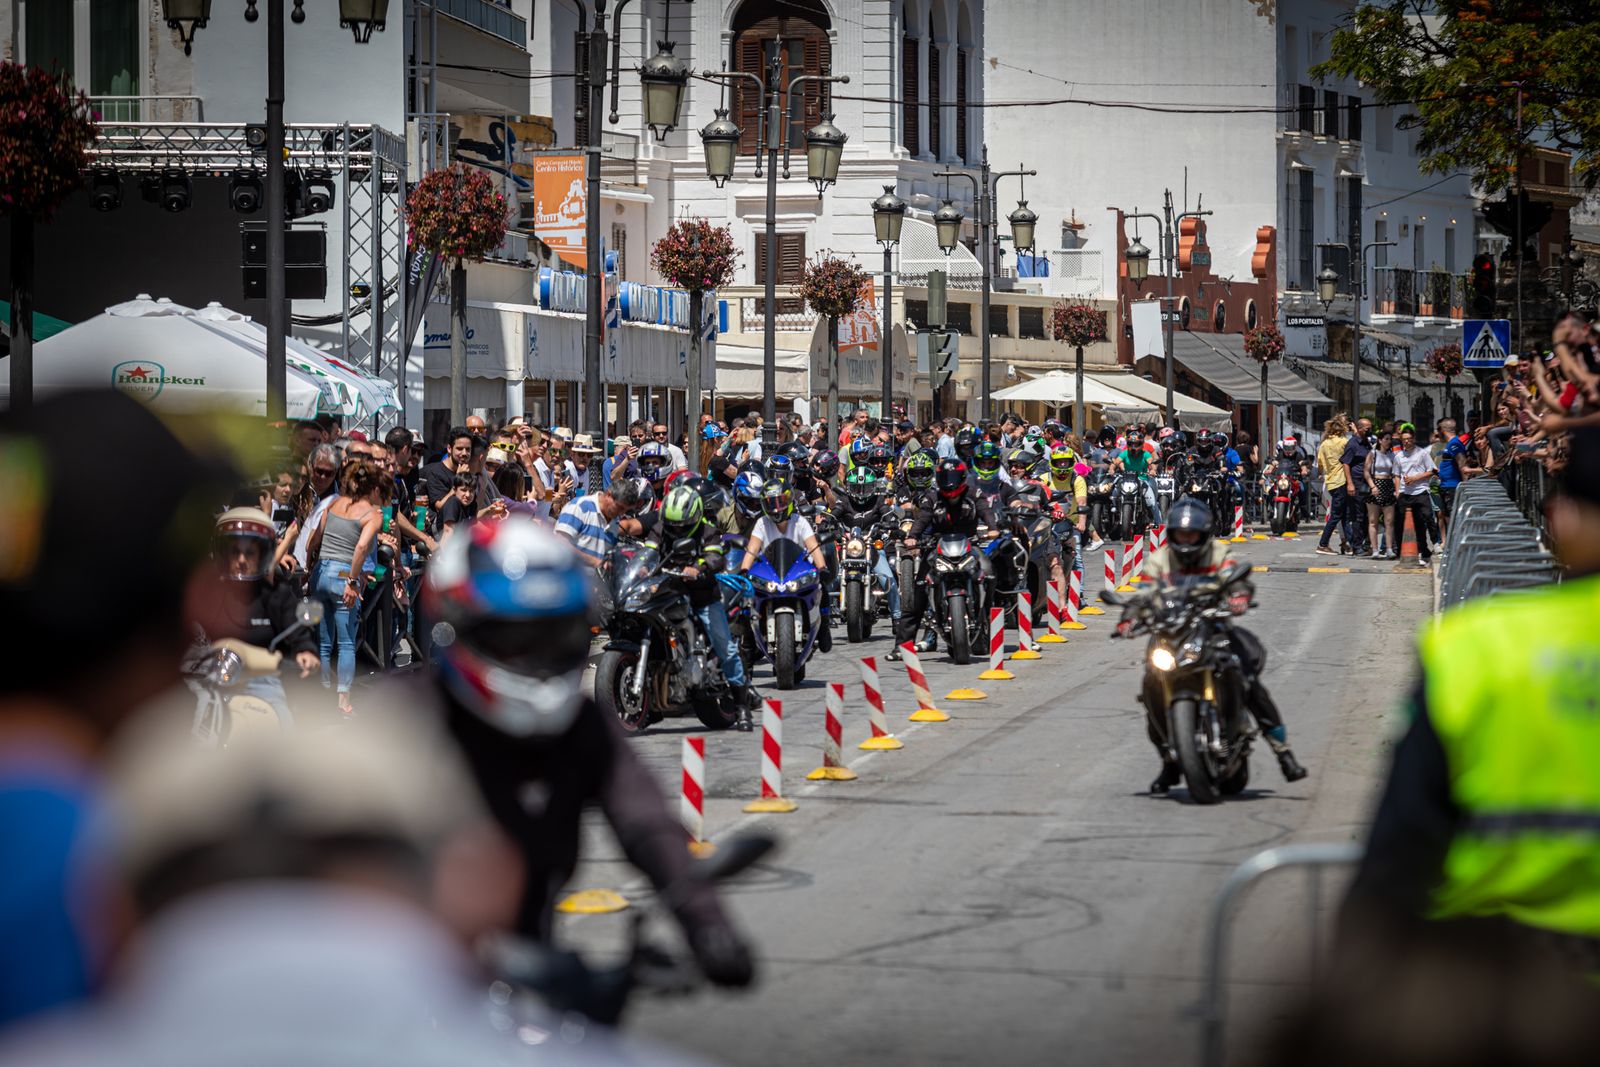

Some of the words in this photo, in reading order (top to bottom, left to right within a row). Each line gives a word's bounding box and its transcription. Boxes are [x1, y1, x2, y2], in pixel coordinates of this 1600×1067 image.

[1287, 317, 1298, 325] LOS
[1298, 317, 1324, 325] PORTALES
[117, 374, 205, 386] Heineken
